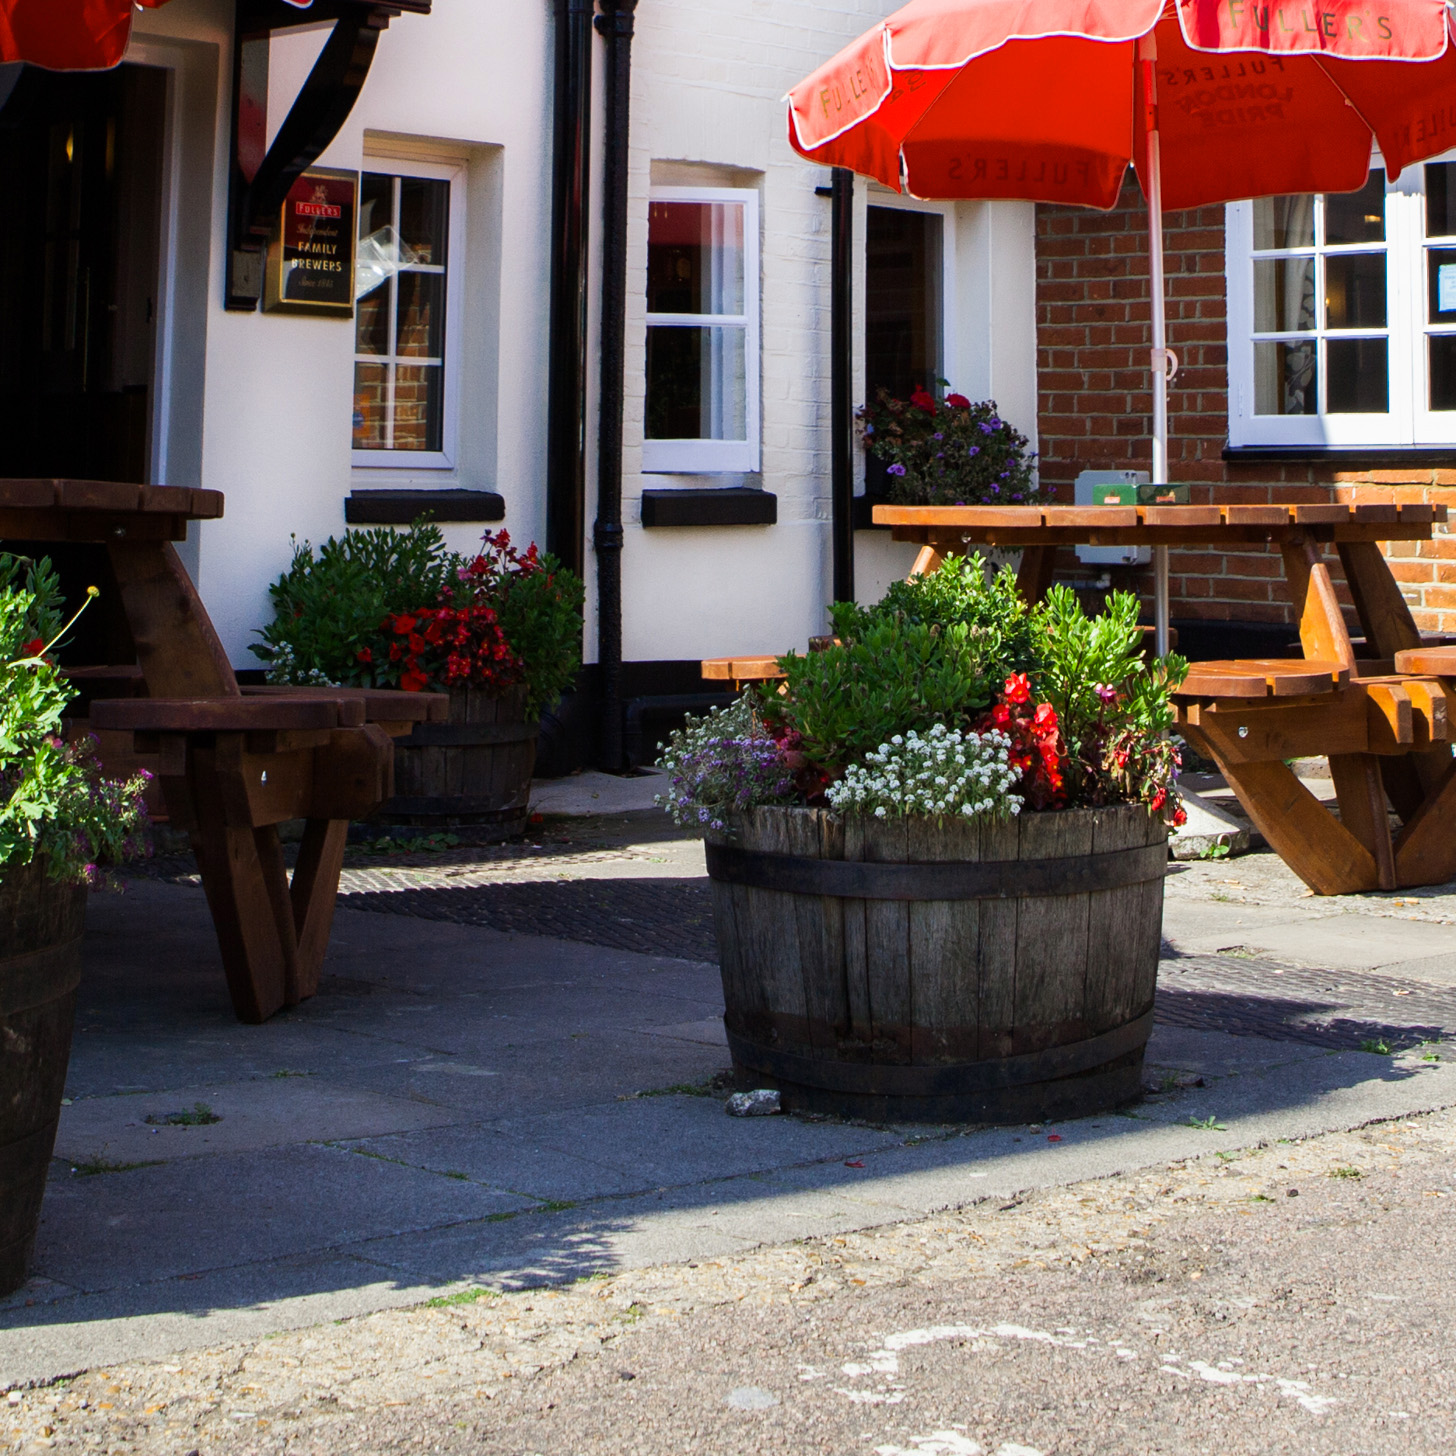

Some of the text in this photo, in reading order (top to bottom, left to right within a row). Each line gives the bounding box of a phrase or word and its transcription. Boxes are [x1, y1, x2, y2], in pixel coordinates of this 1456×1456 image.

[1228, 0, 1393, 42] FULLER'S
[298, 241, 337, 255] FAMILY
[291, 258, 342, 272] BREWERS
